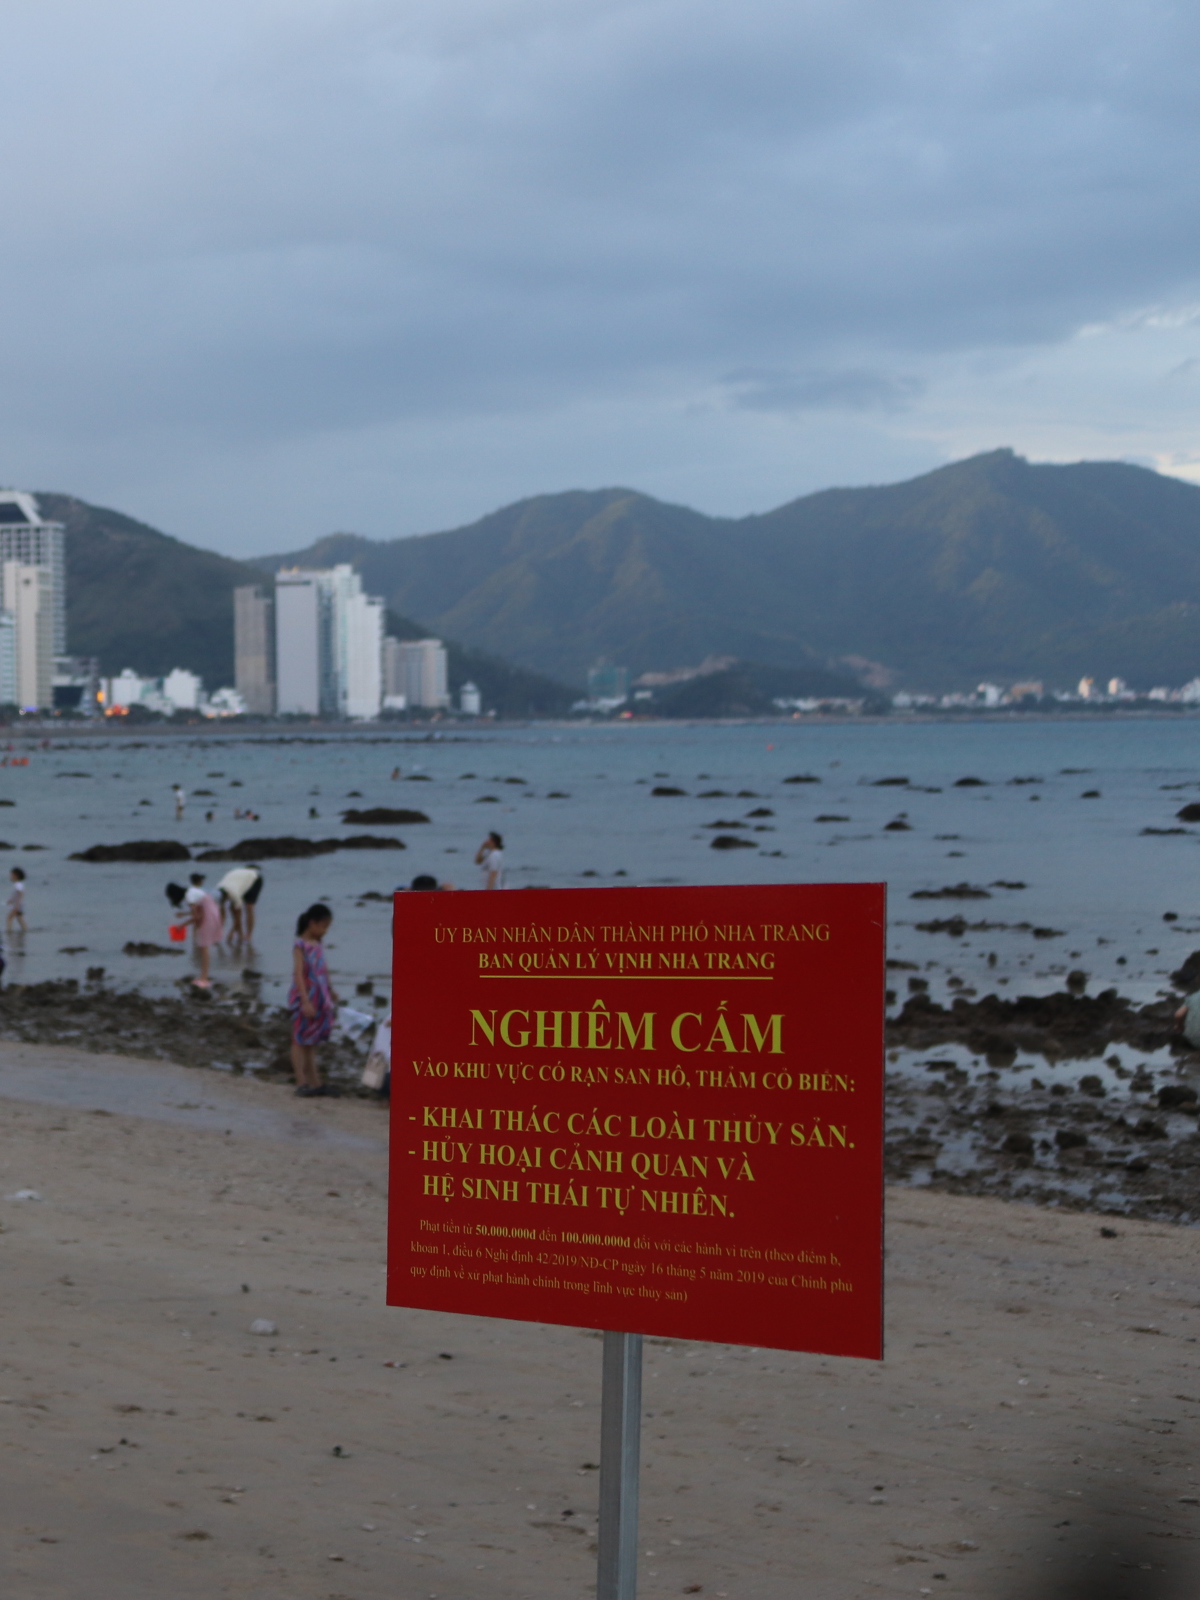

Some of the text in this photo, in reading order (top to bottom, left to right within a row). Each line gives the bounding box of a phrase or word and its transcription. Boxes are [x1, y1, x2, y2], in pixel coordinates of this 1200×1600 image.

[462, 927, 498, 943] BAN
[502, 922, 552, 943] NHÂN
[557, 922, 595, 943] DÂN
[600, 921, 665, 943] THÀNH
[670, 920, 708, 942] PHỐ
[714, 924, 756, 942] NHA
[760, 923, 831, 942] TRANG
[478, 948, 776, 973] BAN QUẢN LÝ VỊNH NHA TRANG
[468, 999, 786, 1054] NGHIÊM CẤM
[412, 1057, 856, 1092] VÀO KHU VỰC CÓ RẠN SAN HÔ, THẢM CỎ BIỂN:
[422, 1106, 484, 1129] KHAI
[490, 1105, 561, 1134] THÁC
[567, 1107, 622, 1136] CÁC
[629, 1111, 696, 1140] LOÀI
[703, 1114, 783, 1145] THỦY
[790, 1117, 856, 1149] SẢN.
[422, 1135, 473, 1164] HỦY
[479, 1144, 542, 1173] HOẠI
[549, 1142, 623, 1174] CẢNH
[630, 1151, 709, 1180] QUAN
[717, 1150, 757, 1181] VÀ
[422, 1173, 736, 1219] HỆ SINH THÁI TỰ NHIÊN.
[419, 1219, 440, 1234] Phạt
[442, 1218, 460, 1234] tiền
[463, 1222, 474, 1235] từ
[475, 1225, 536, 1240] 50.000.000đ
[538, 1226, 558, 1242] đến
[560, 1231, 631, 1248] 100.000.000đ
[633, 1235, 651, 1250] đối
[654, 1240, 671, 1251] với
[674, 1242, 693, 1253] các
[695, 1242, 723, 1256] hành
[725, 1246, 736, 1257] vi
[739, 1247, 762, 1259] trên
[764, 1248, 794, 1262] (theo
[410, 1266, 428, 1277] quy
[429, 1265, 451, 1279] định
[453, 1265, 465, 1279] về
[482, 1271, 504, 1285] phạt
[506, 1273, 530, 1286] hành
[532, 1275, 560, 1289] chính
[563, 1279, 590, 1294] trong
[593, 1280, 613, 1295] lĩnh
[452, 1242, 473, 1258] điều
[475, 1247, 483, 1258] 6
[485, 1248, 509, 1263] Nghị
[511, 1250, 534, 1264] định
[621, 1260, 647, 1276] ngày
[650, 1262, 664, 1274] 16
[666, 1264, 696, 1280] tháng
[699, 1268, 707, 1278] 5
[709, 1269, 734, 1281] năm
[736, 1270, 765, 1284] 2019
[791, 1274, 827, 1290] Chính
